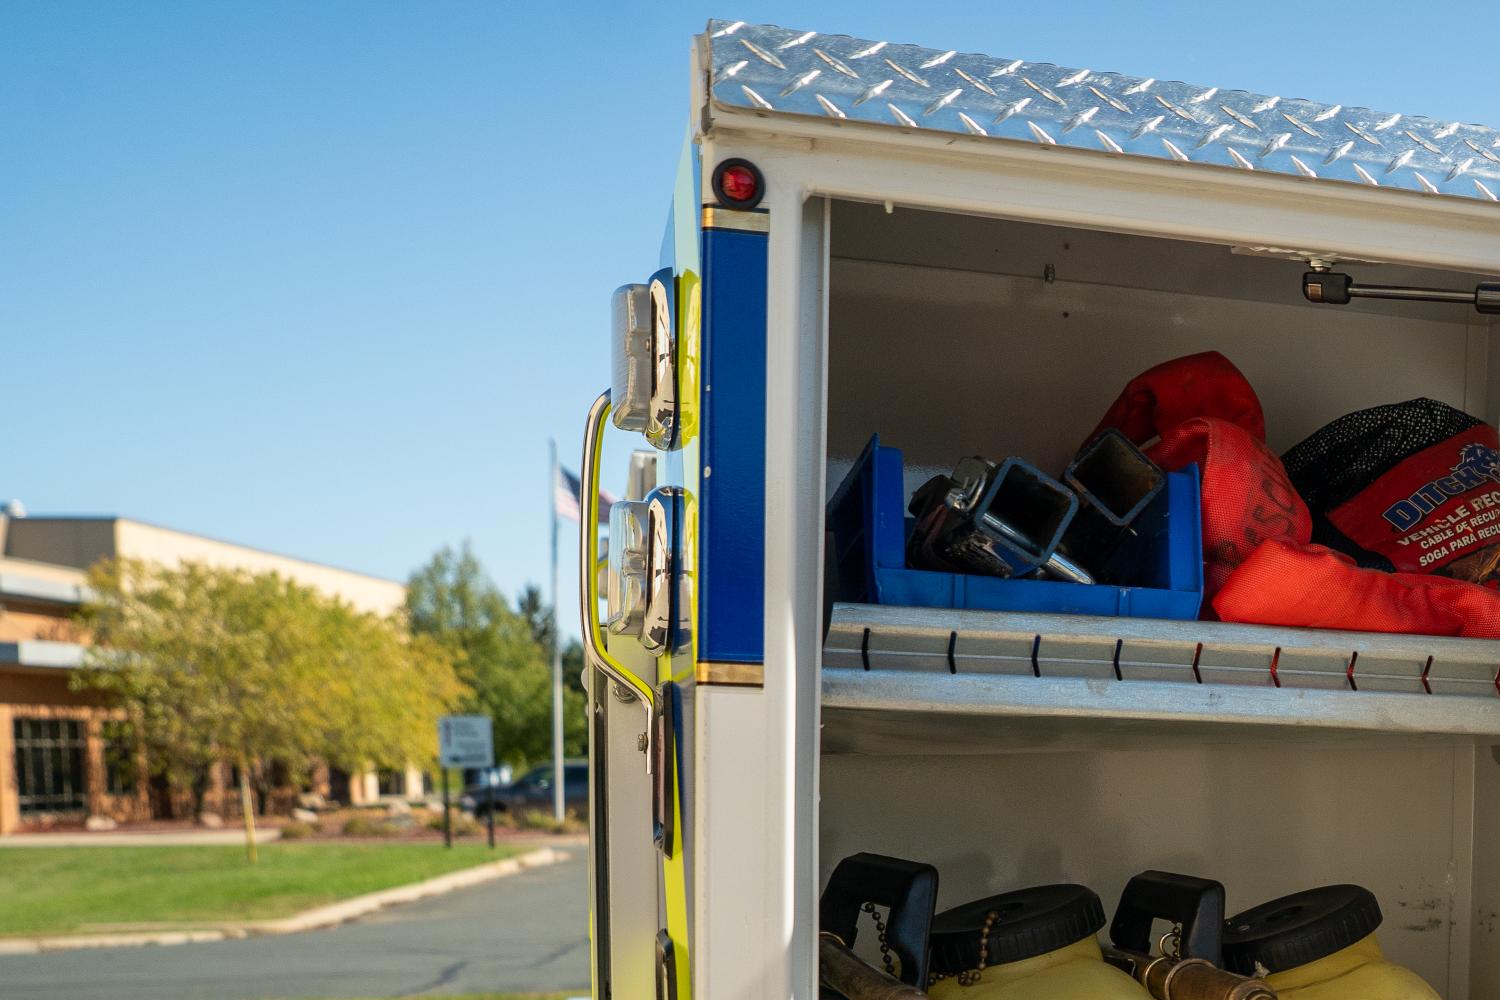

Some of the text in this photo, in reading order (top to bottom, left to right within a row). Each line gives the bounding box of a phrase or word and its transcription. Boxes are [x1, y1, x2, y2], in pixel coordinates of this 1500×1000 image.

[1382, 466, 1488, 532] DITCH
[1397, 505, 1471, 546] VEHICLE
[1455, 521, 1471, 534] DE
[1420, 547, 1449, 567] SOGA
[1450, 533, 1478, 552] PARA
